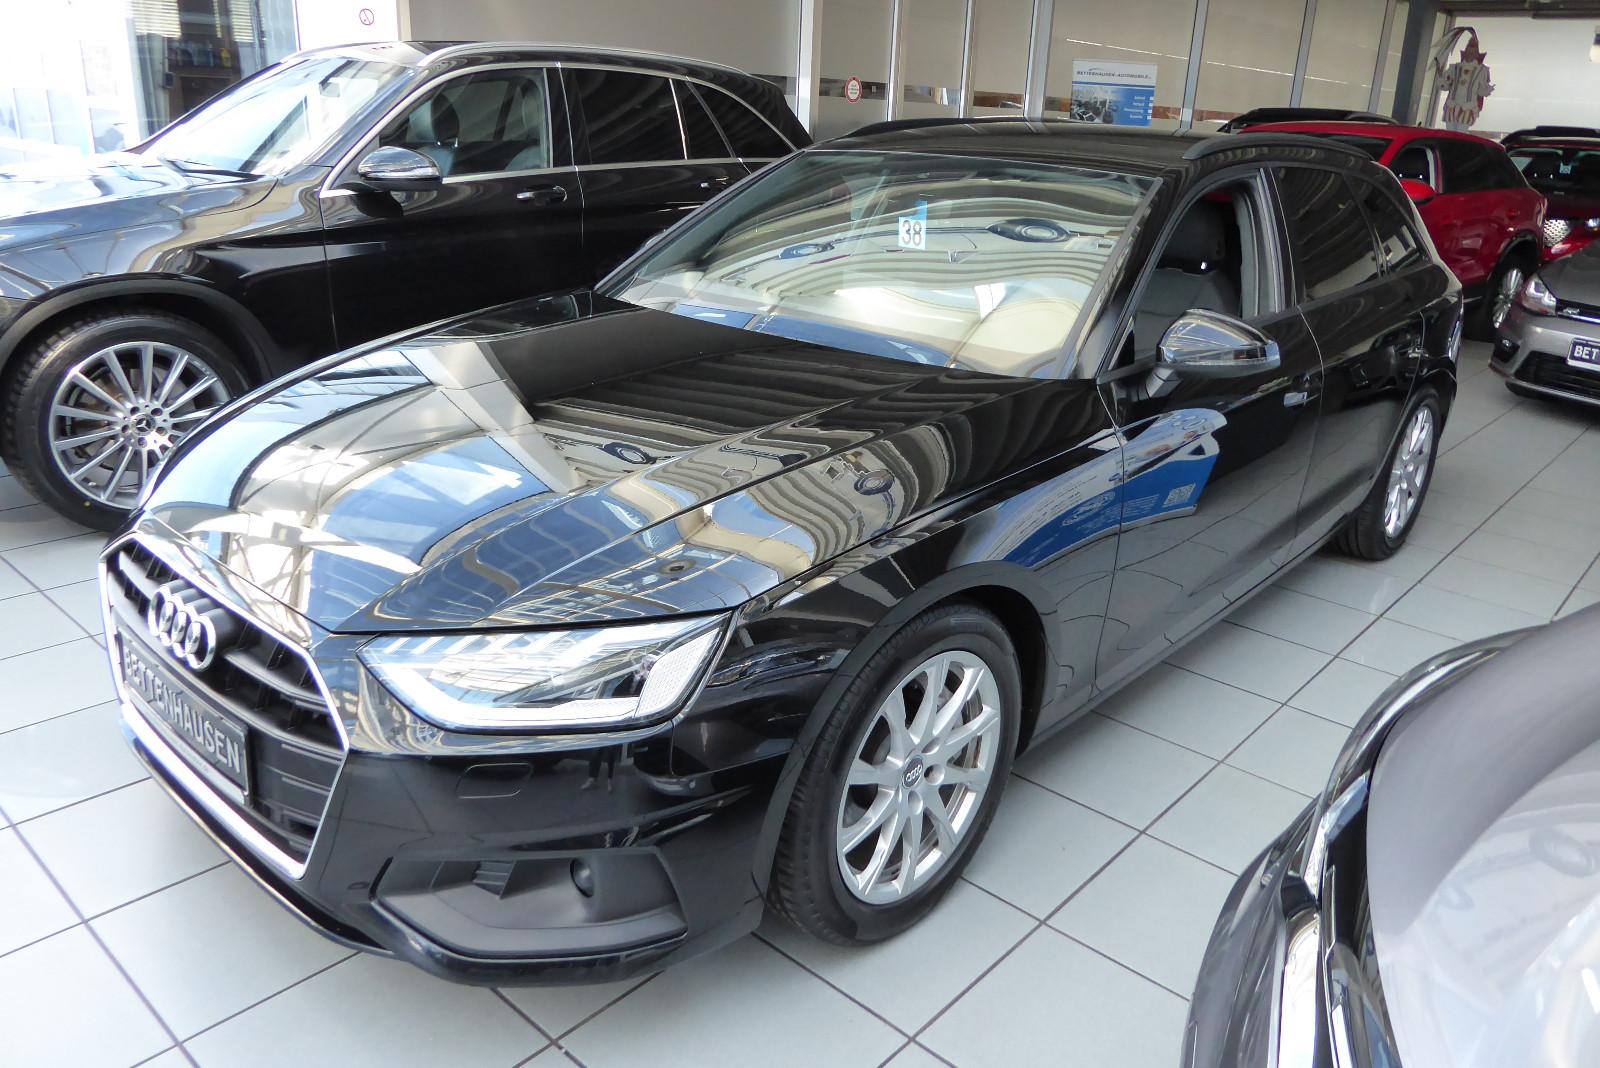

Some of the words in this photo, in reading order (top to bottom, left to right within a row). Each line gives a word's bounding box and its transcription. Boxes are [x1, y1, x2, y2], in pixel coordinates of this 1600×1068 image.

[902, 219, 922, 246] 38
[1573, 345, 1600, 360] BET
[123, 646, 241, 774] BETTENHAUSEN
